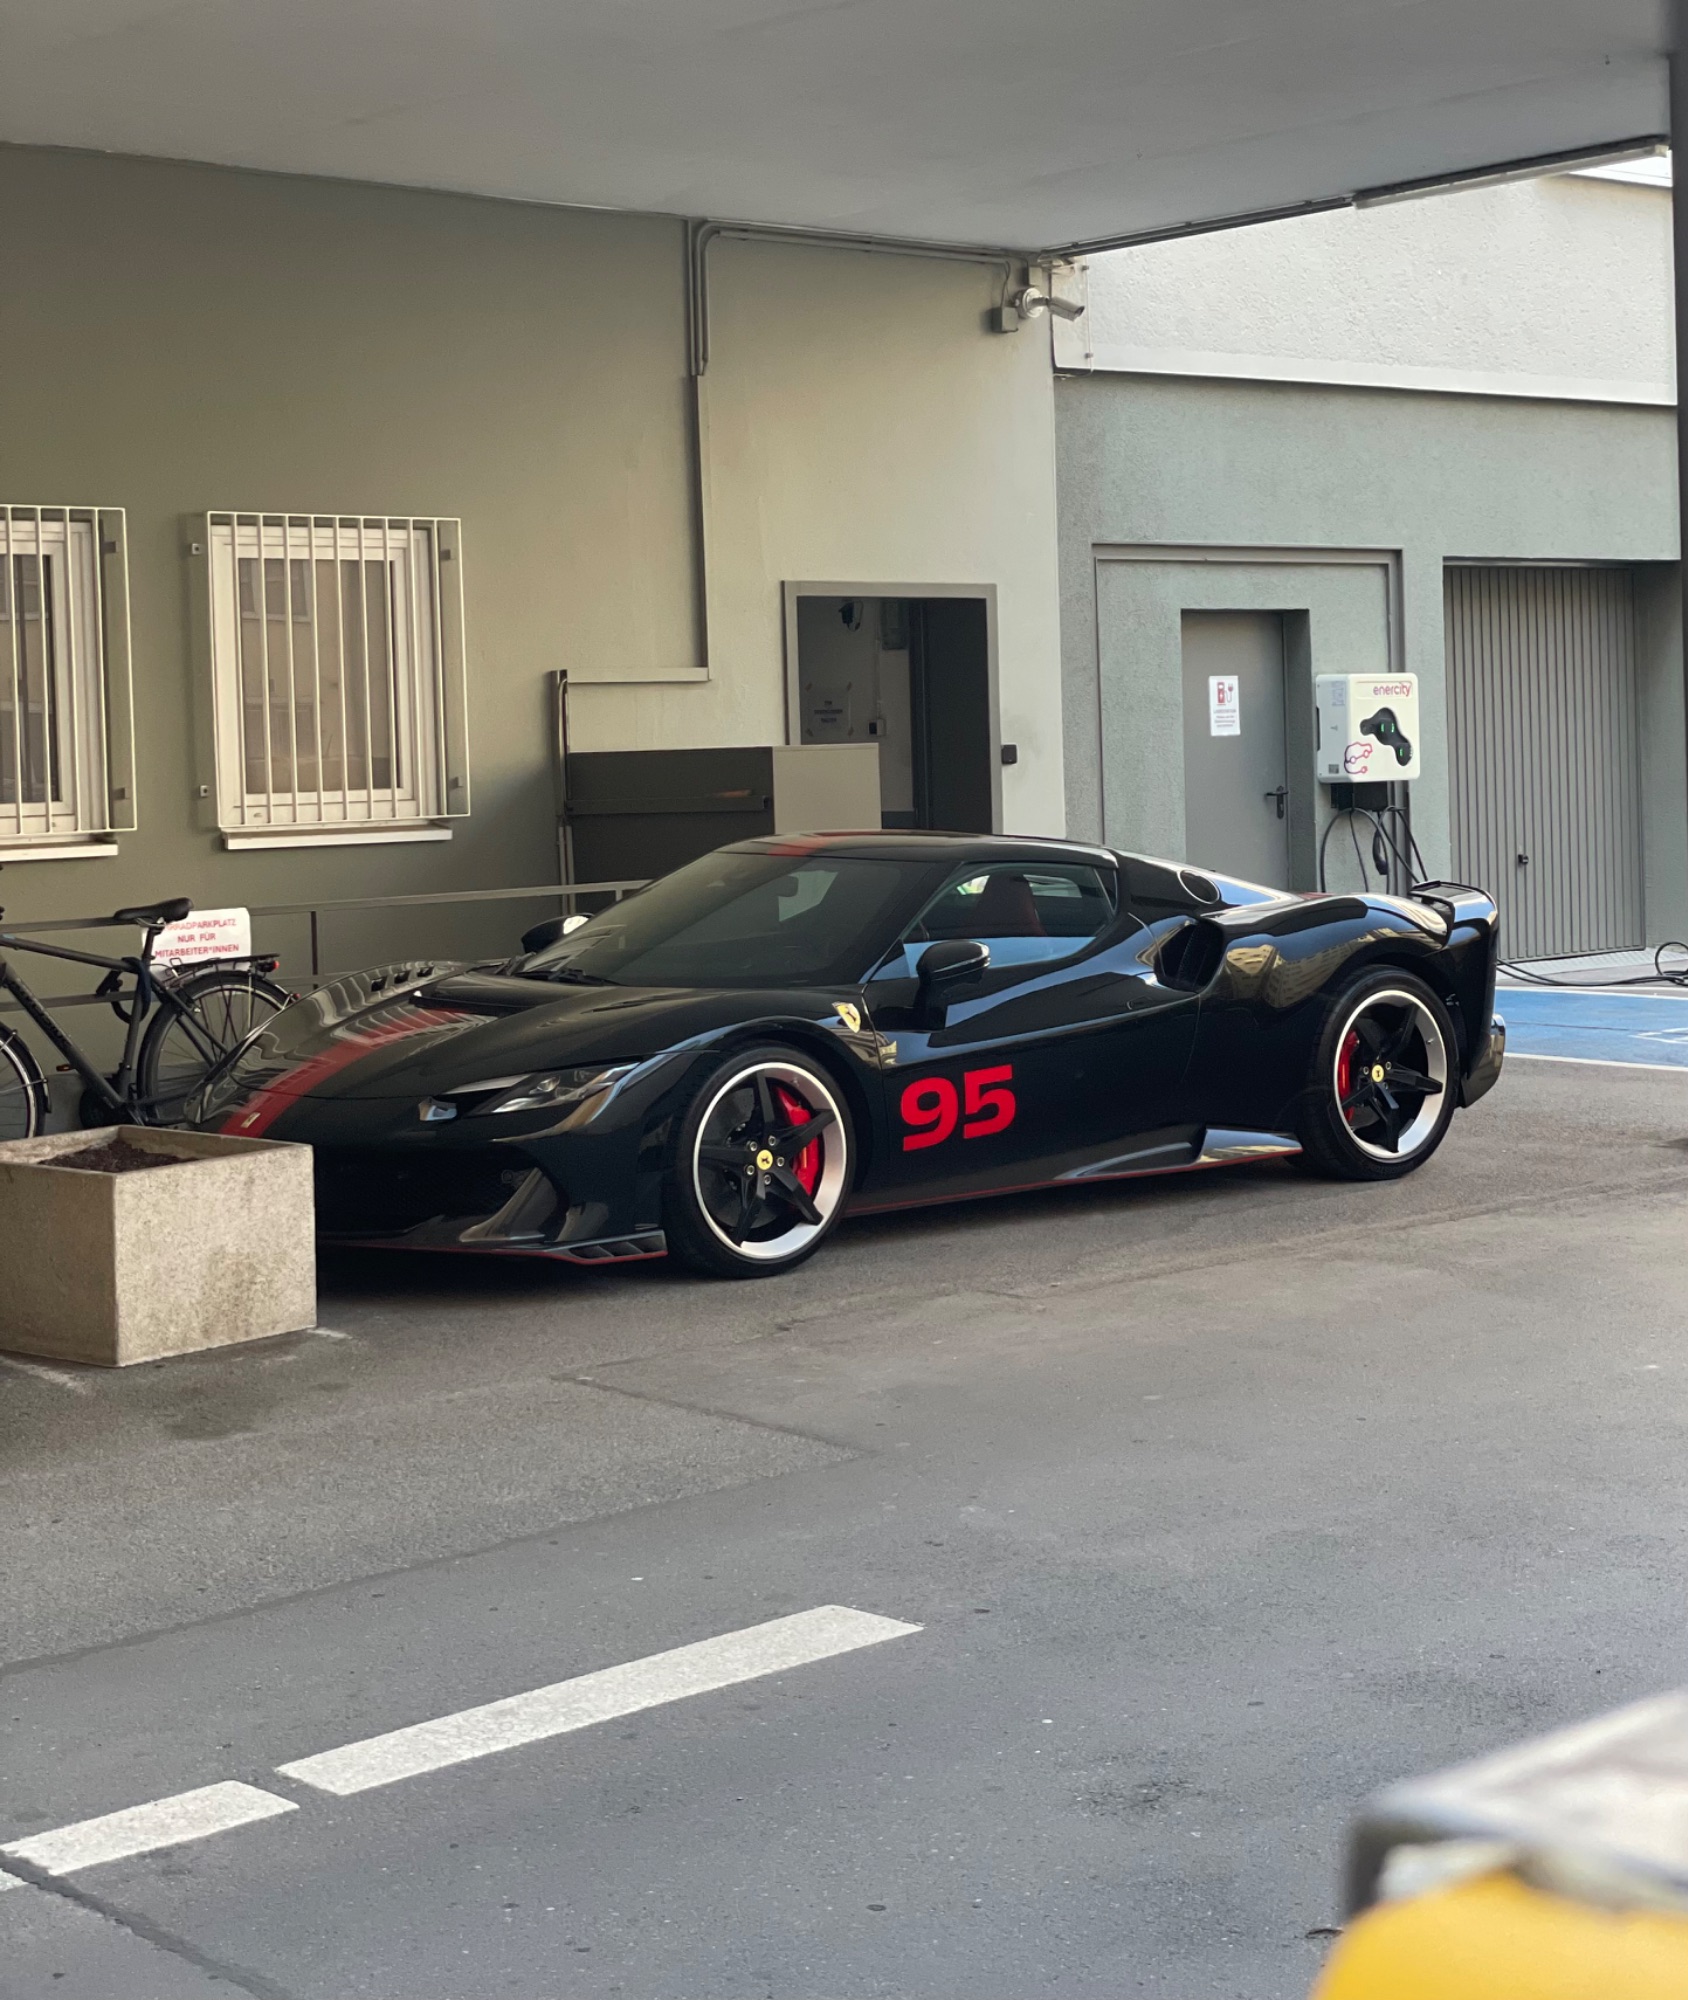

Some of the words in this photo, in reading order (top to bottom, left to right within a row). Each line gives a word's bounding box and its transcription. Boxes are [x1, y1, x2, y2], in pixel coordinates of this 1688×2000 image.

[1373, 684, 1411, 697] enercity
[166, 919, 237, 931] RRADPARKPLATZ
[177, 934, 196, 943] NUR
[199, 932, 217, 941] FÜR
[901, 1064, 1016, 1152] 95
